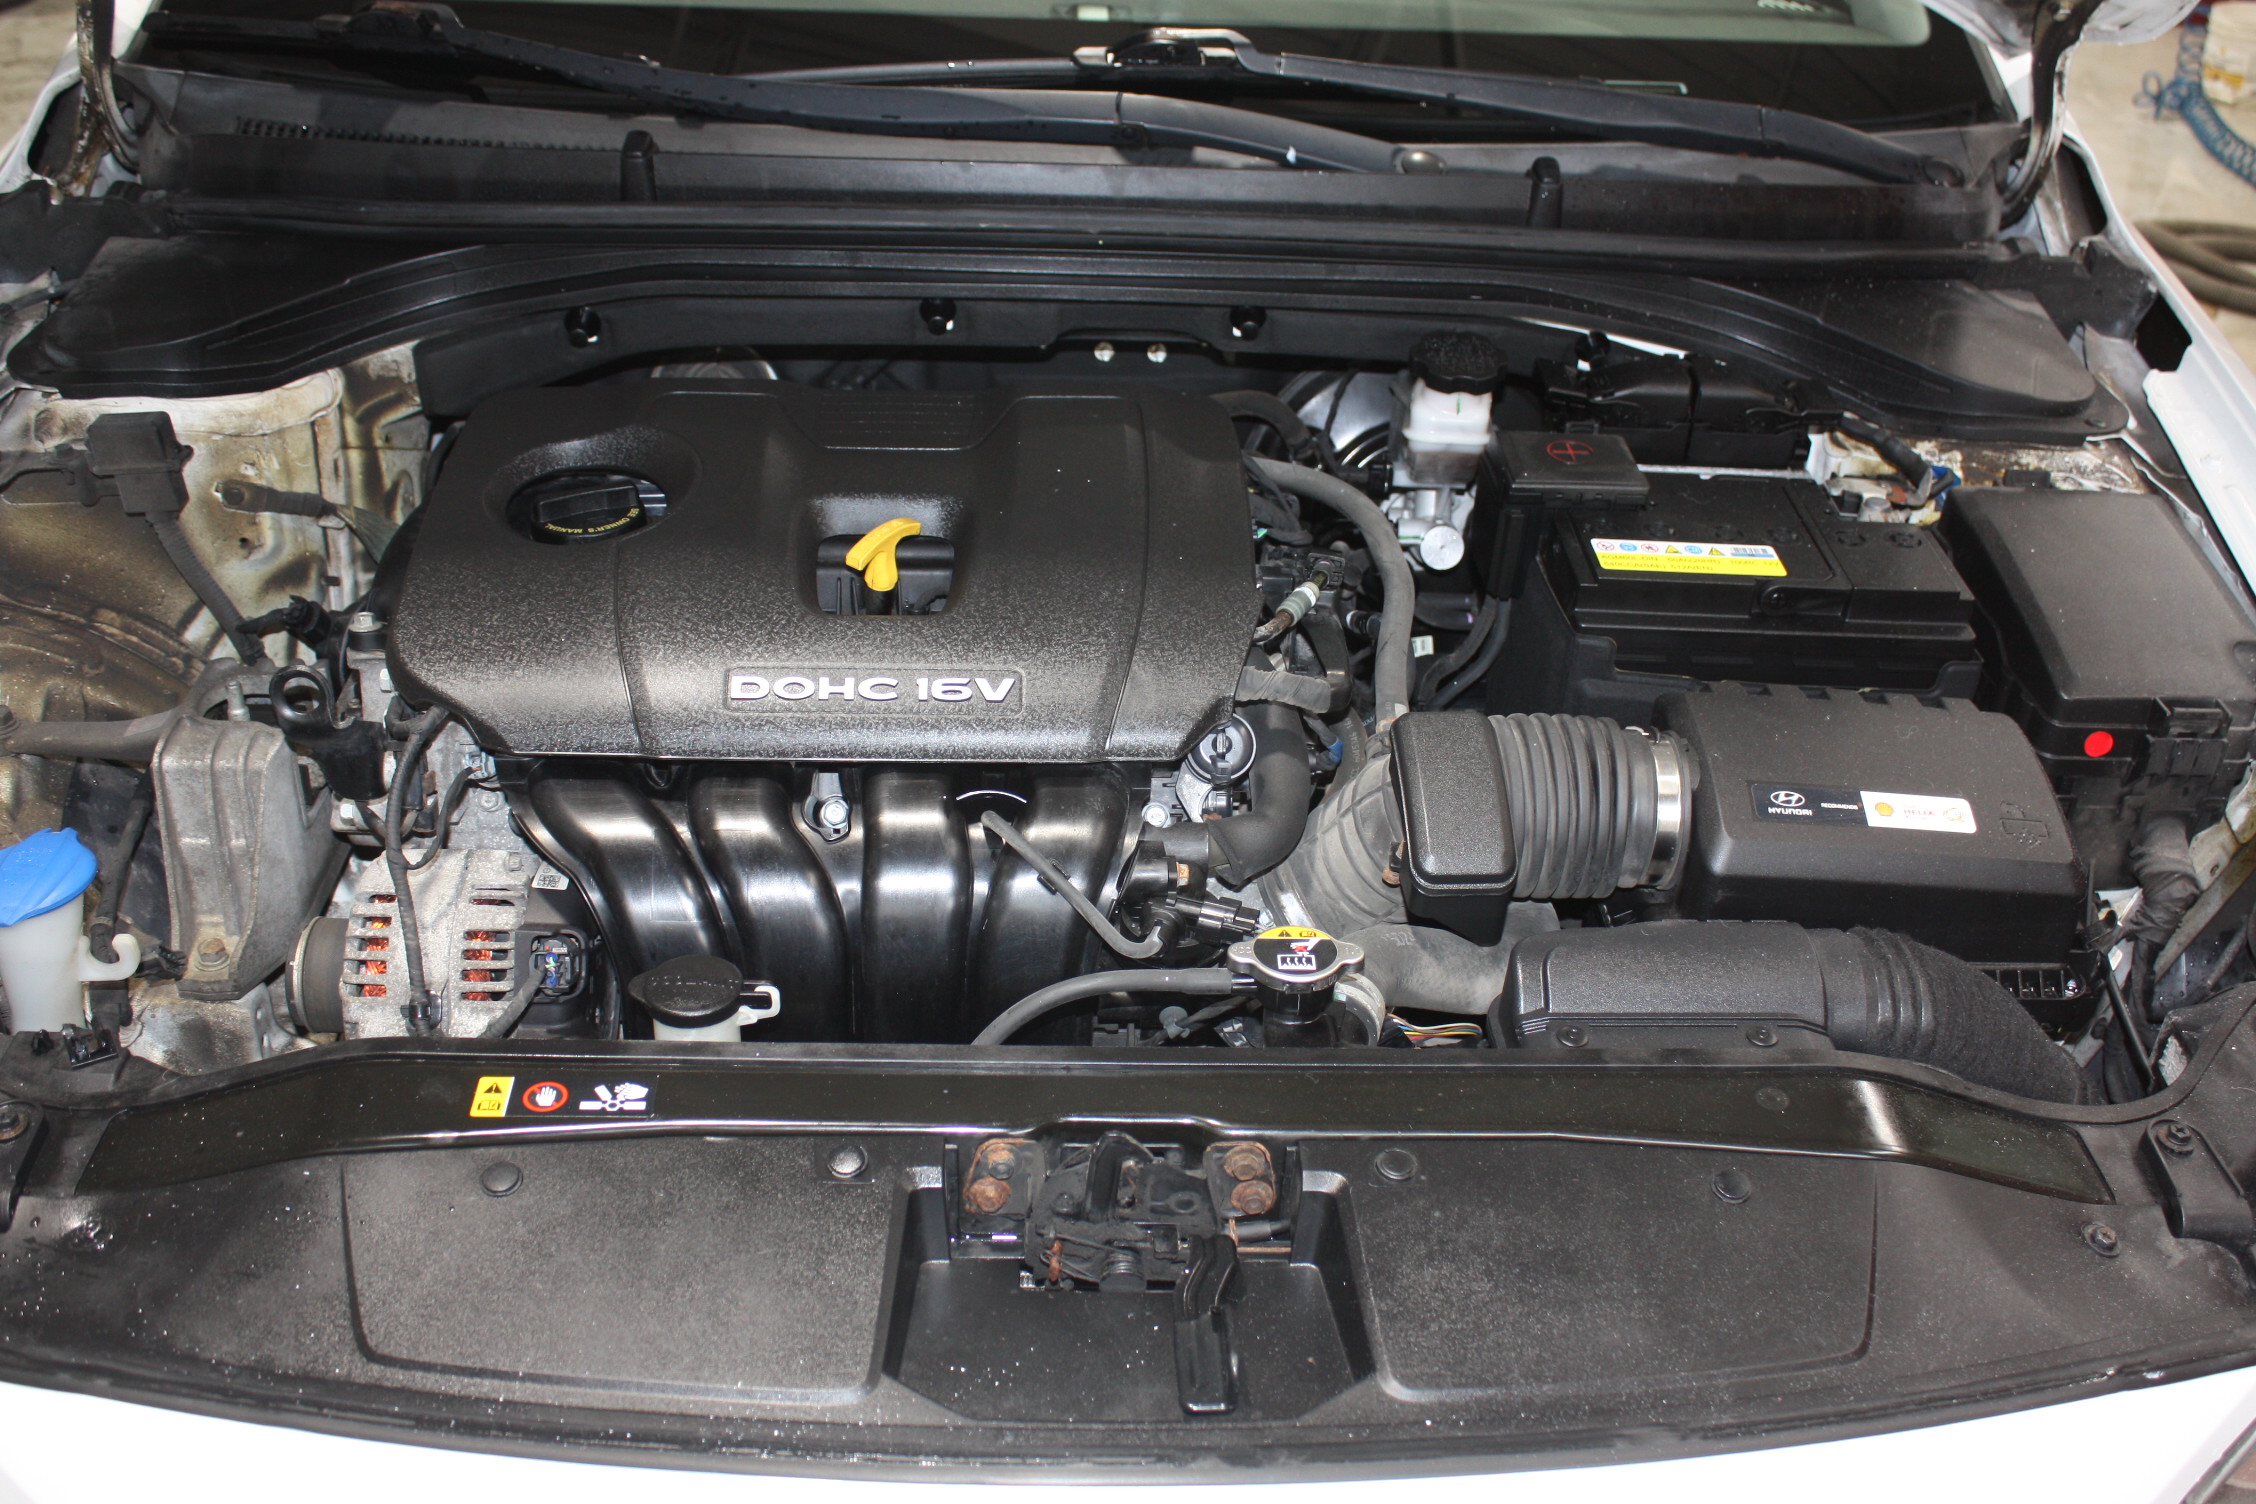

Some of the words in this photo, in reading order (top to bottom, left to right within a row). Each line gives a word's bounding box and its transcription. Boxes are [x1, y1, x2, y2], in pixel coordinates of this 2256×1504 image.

[545, 523, 583, 534] MANUAL
[588, 517, 630, 533] OWNER'S
[730, 675, 899, 701] DOHC
[916, 676, 1016, 703] 16V
[1767, 806, 1813, 817] HYUNDAI
[1820, 802, 1859, 810] RECOMMENDS
